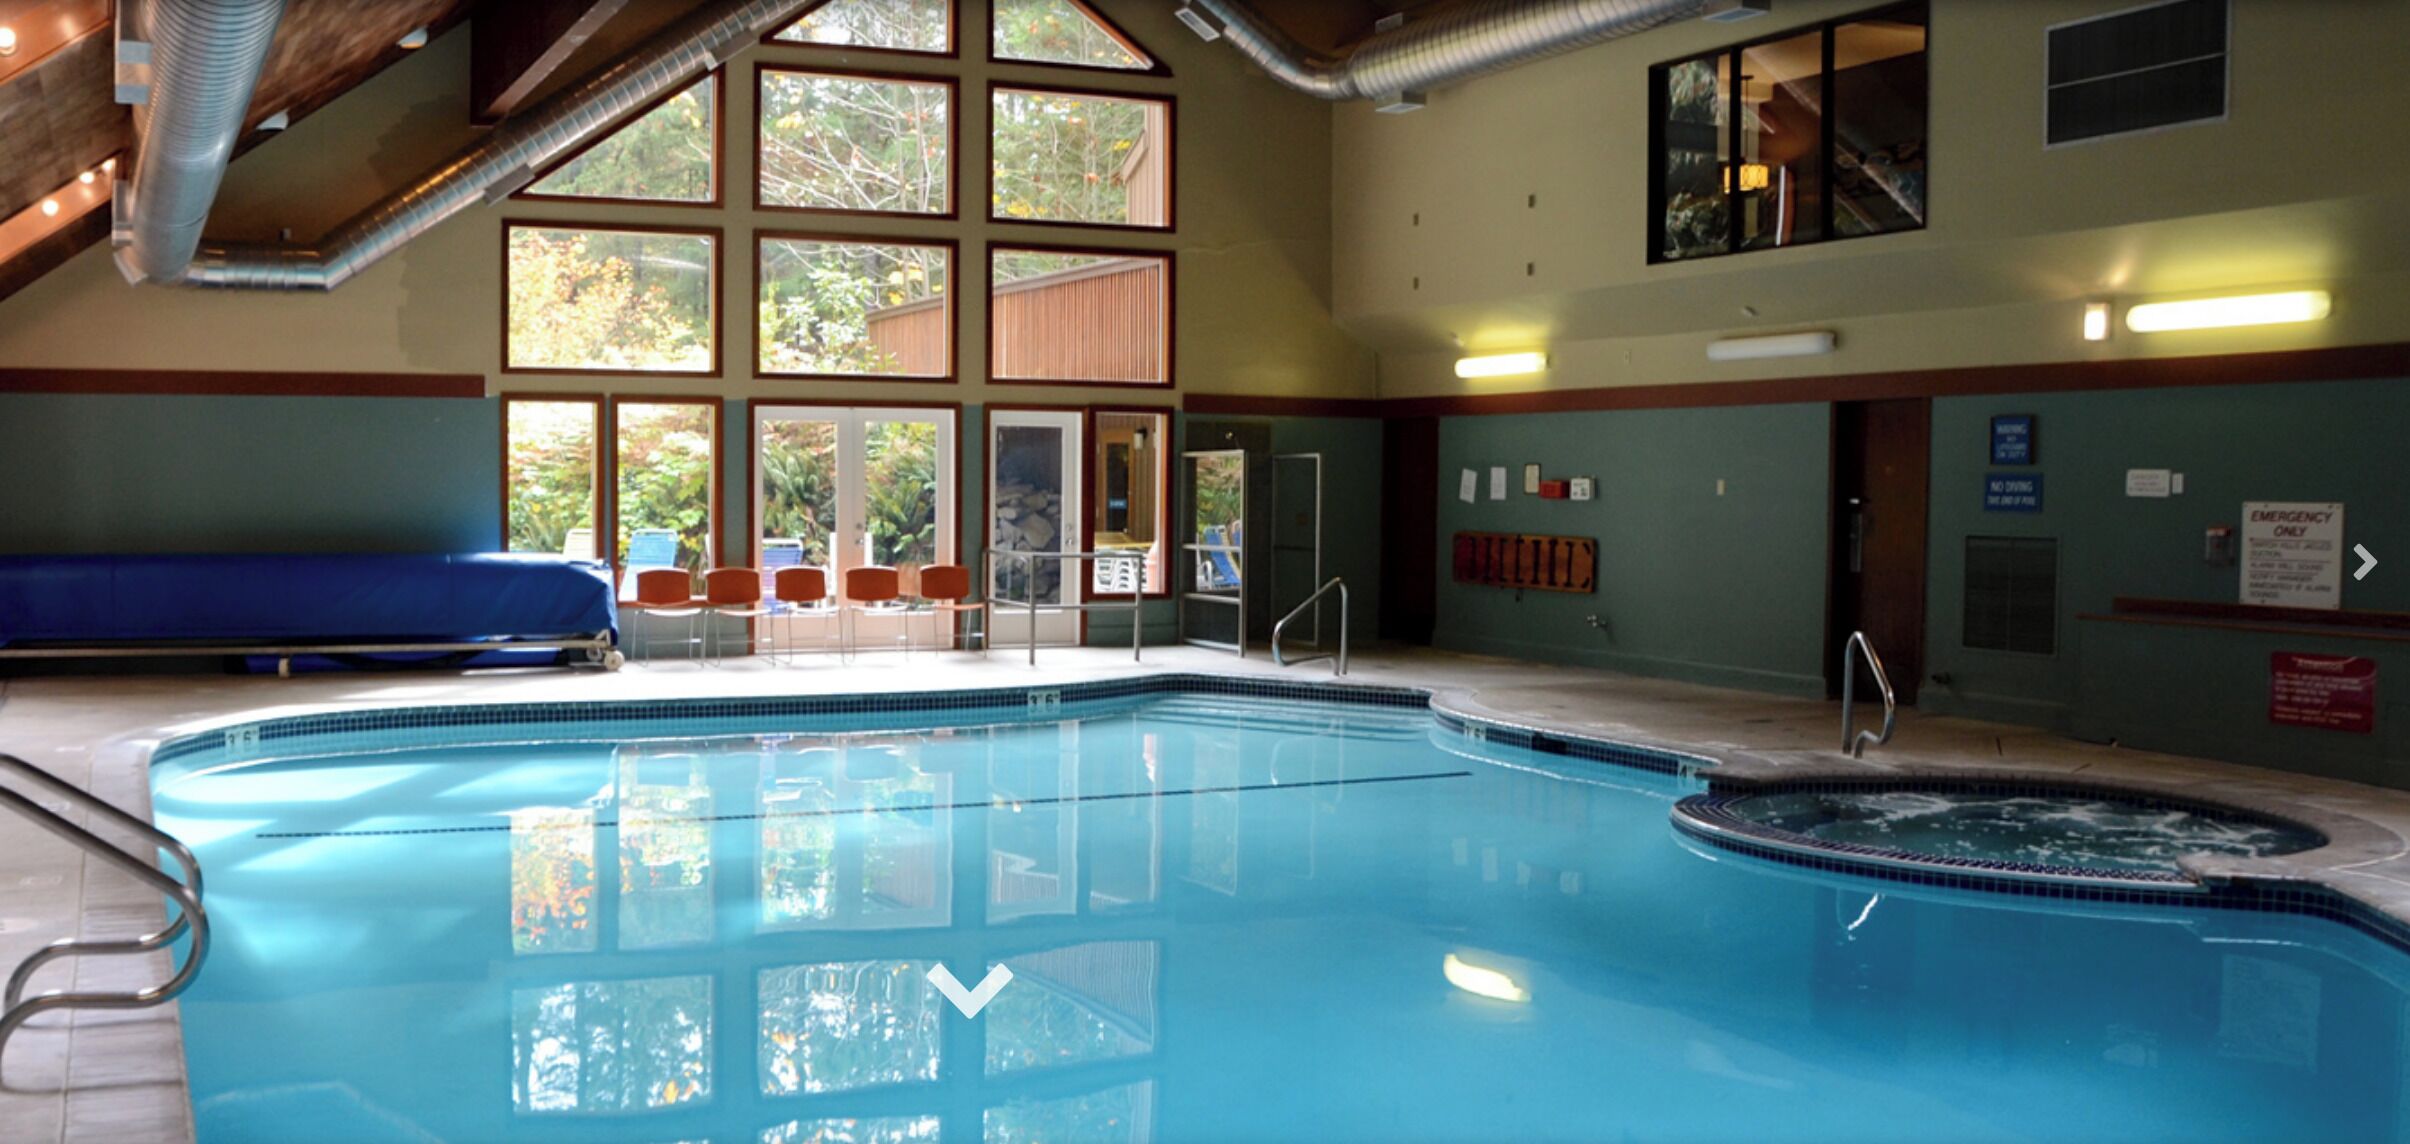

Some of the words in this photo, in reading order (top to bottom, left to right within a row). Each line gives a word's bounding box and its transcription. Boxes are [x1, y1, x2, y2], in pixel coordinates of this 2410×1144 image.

[1990, 480, 2004, 493] NO
[2005, 480, 2033, 493] DIVING
[2250, 510, 2333, 524] EMERGENCY
[2273, 525, 2307, 538] ONLY
